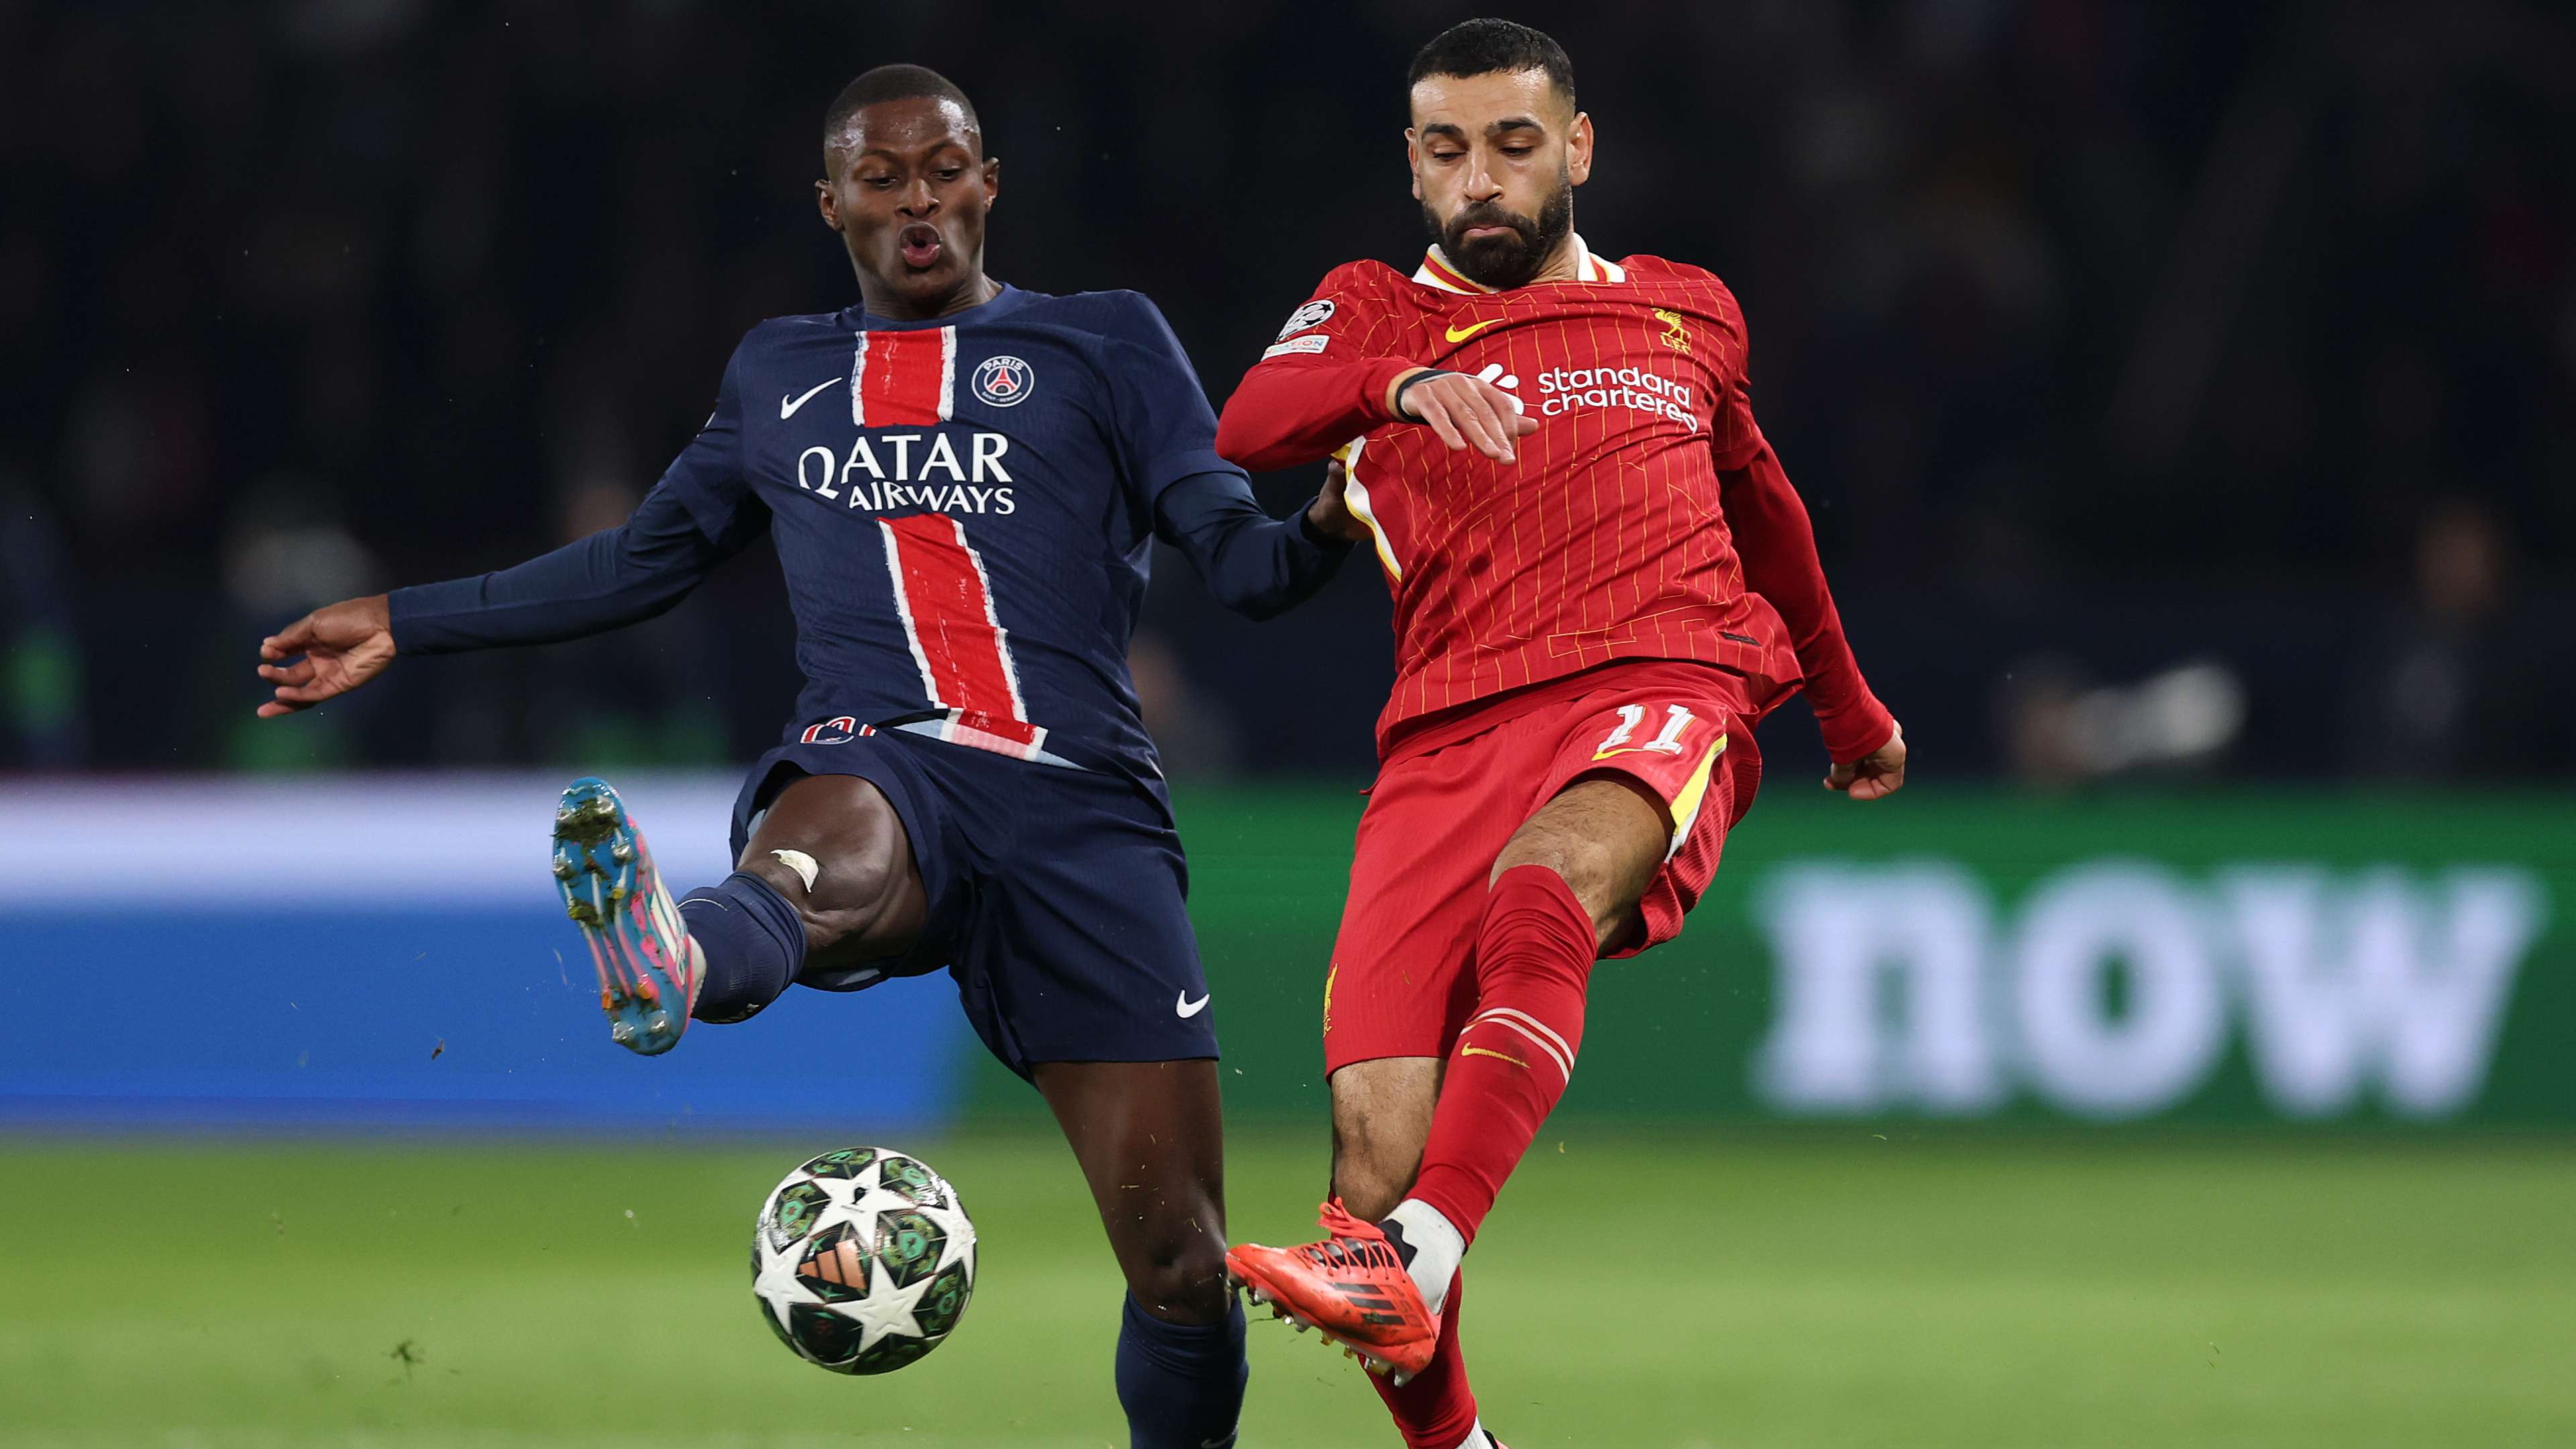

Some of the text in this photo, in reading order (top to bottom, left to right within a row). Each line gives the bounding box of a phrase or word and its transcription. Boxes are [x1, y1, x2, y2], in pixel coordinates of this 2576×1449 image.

[983, 358, 1024, 371] PARIS
[798, 433, 1013, 500] QATAR
[849, 481, 1016, 515] AIRWAYS
[1596, 704, 1695, 755] 11
[1756, 861, 2541, 1118] now
